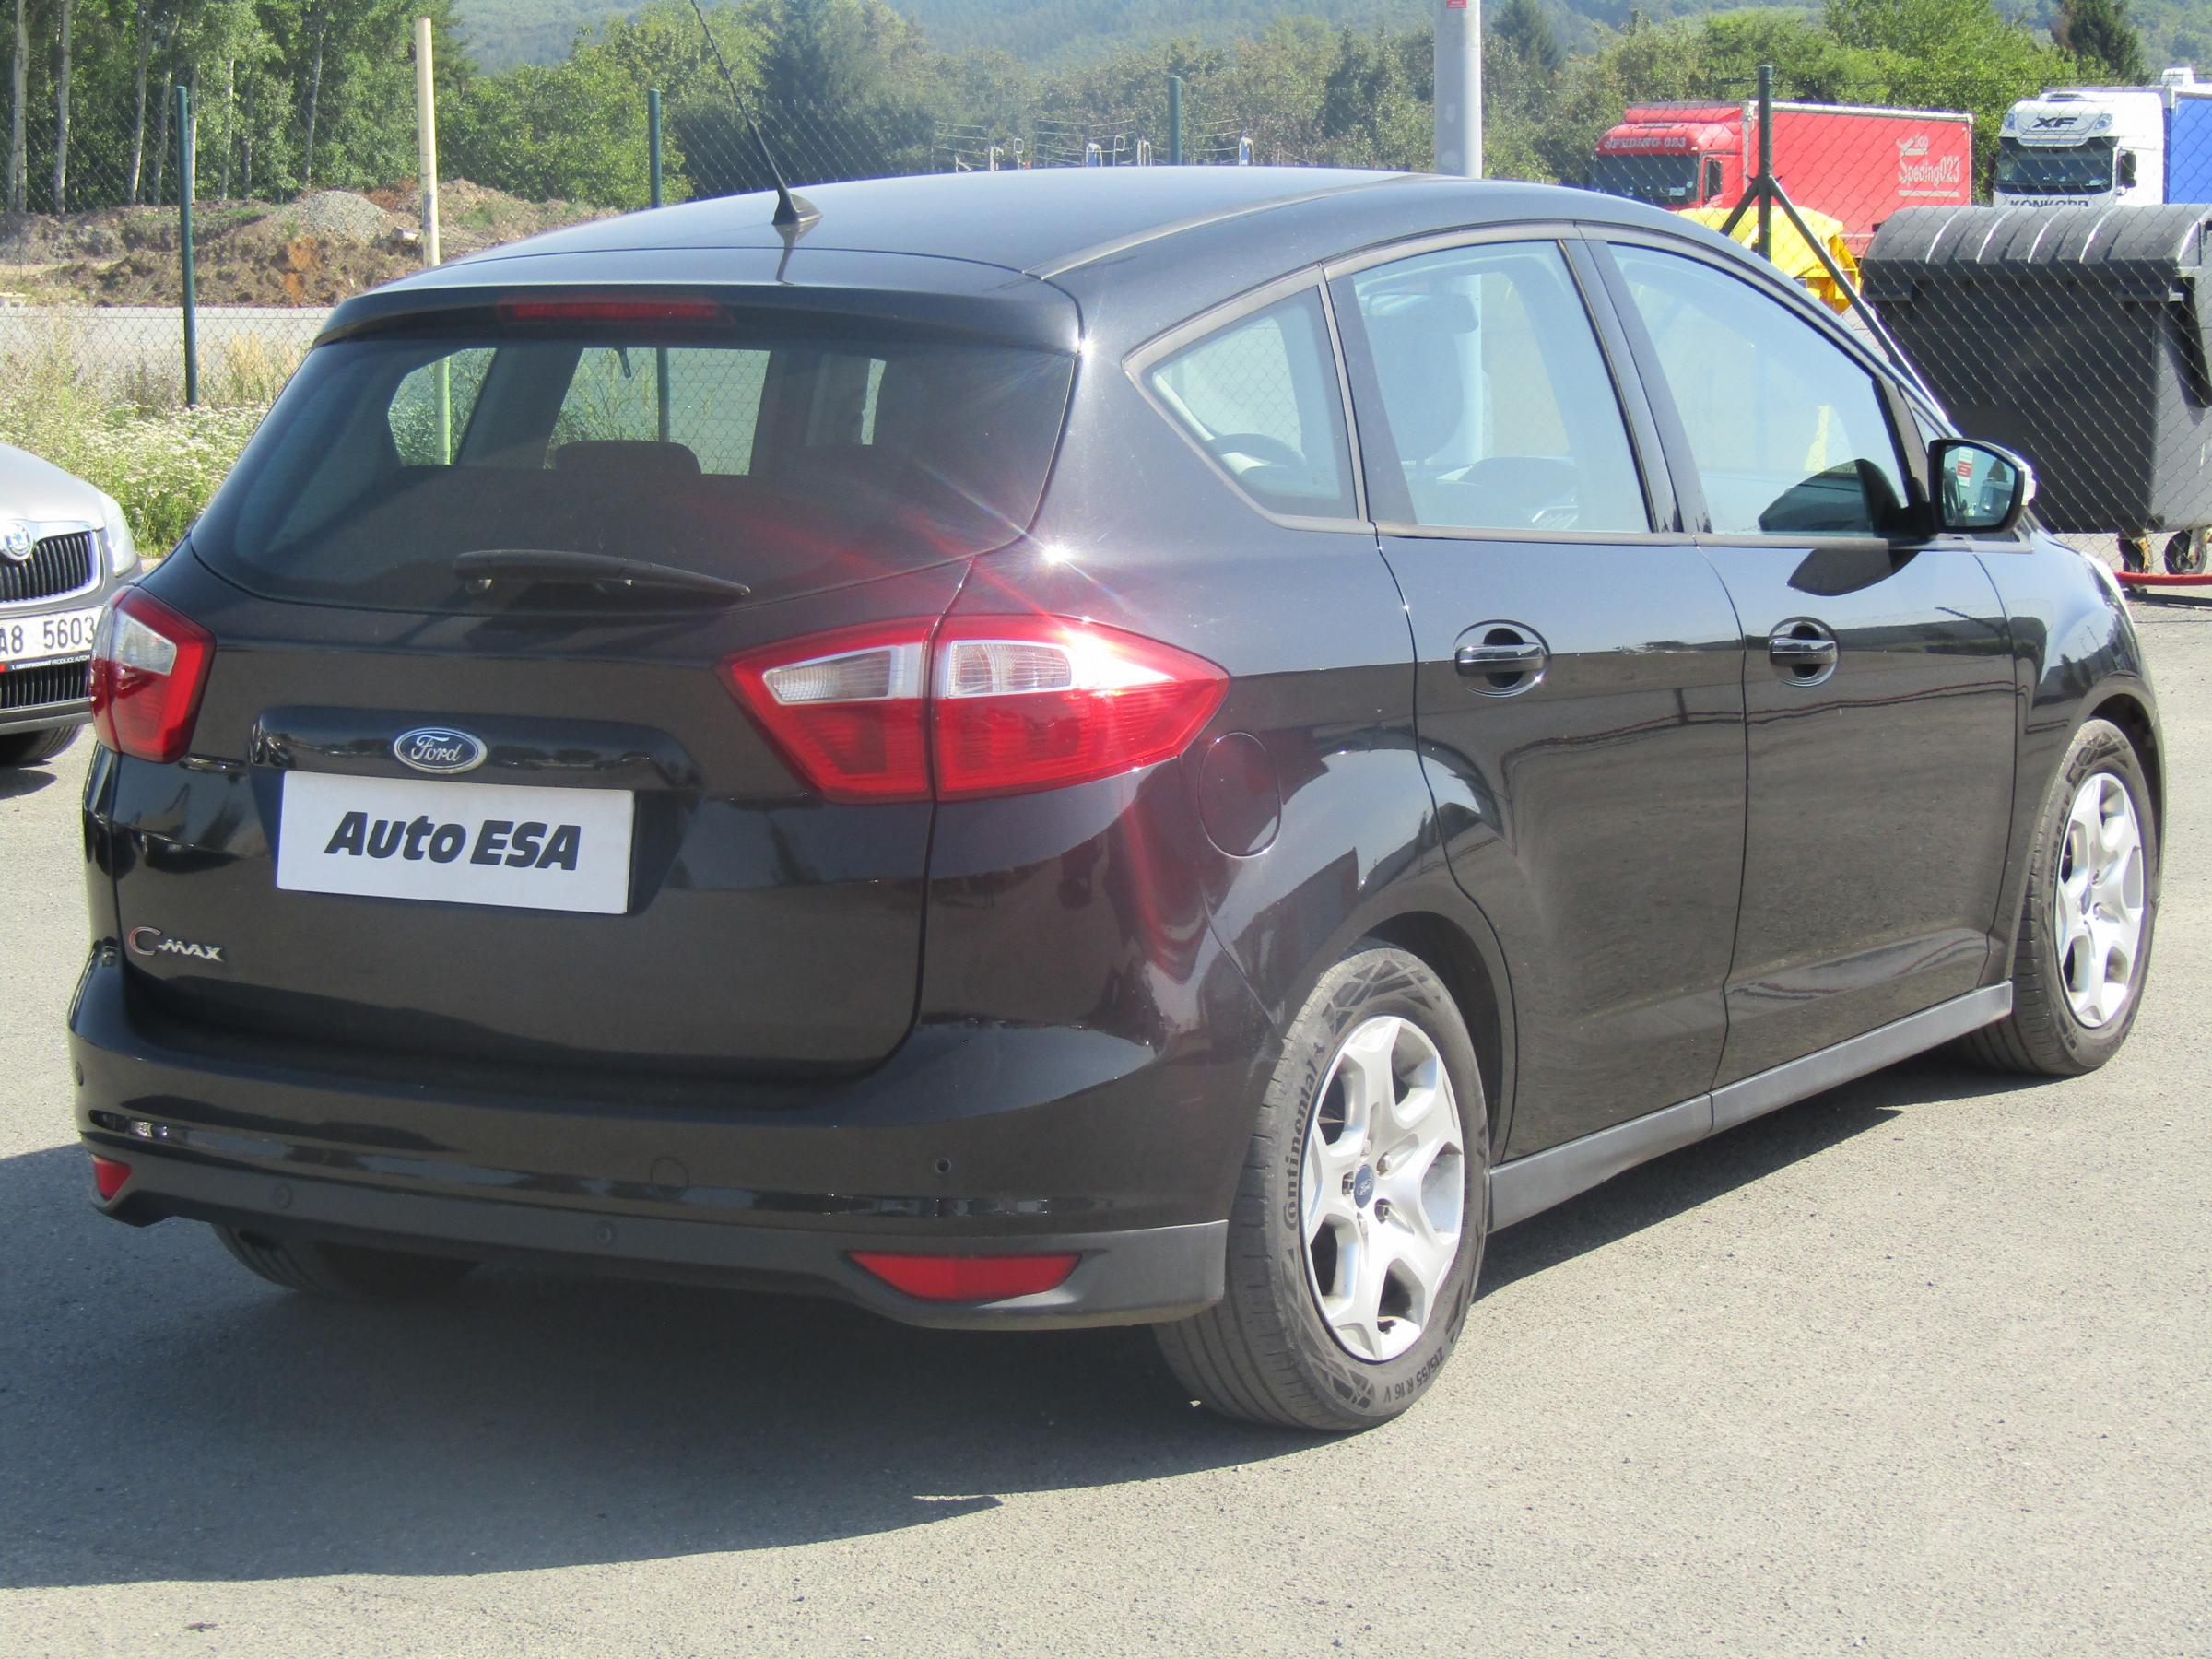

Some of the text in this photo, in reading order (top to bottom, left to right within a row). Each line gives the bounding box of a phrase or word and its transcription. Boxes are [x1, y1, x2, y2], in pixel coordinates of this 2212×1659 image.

[2032, 117, 2077, 128] XF
[43, 615, 95, 650] 5603
[411, 735, 463, 762] Ford
[324, 811, 582, 871] Auto ESA
[1283, 1060, 1318, 1231] Continental
[1384, 1346, 1445, 1403] 215/55 R 16 V
